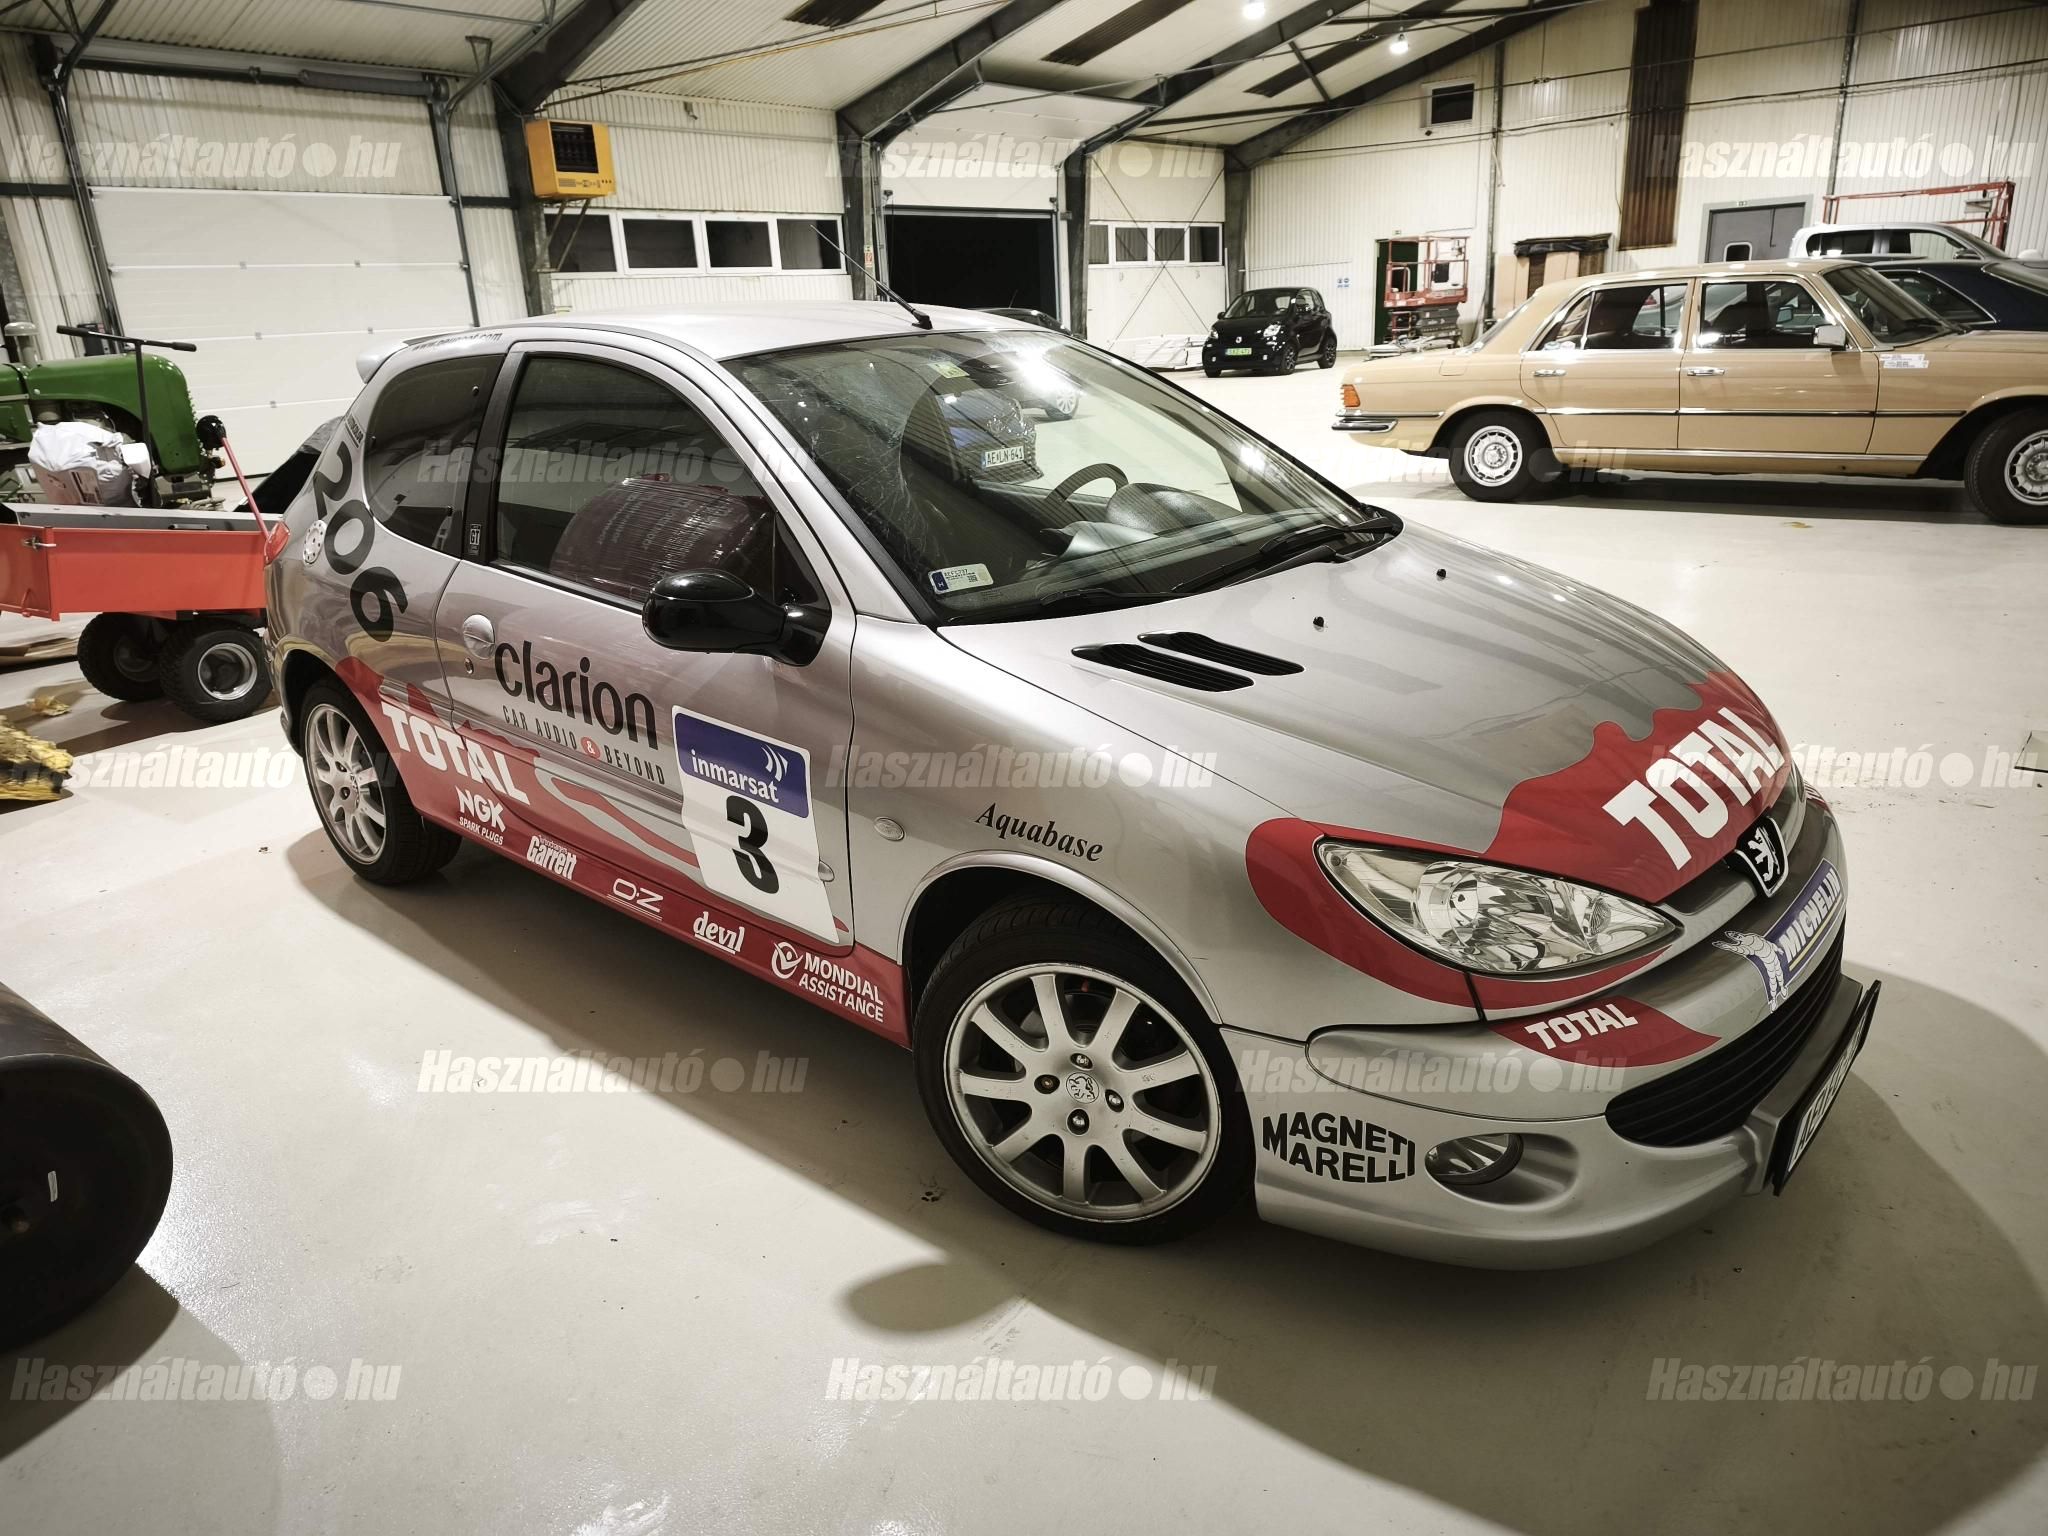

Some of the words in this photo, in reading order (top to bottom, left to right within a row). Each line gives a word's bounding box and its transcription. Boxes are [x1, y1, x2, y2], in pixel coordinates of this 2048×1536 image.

[313, 441, 409, 642] 206
[381, 701, 530, 805] TOTAL
[503, 705, 528, 731] CAR
[535, 717, 577, 750] AUDIO
[604, 744, 665, 785] BEYOND
[691, 749, 779, 803] inmarsat
[1601, 707, 1785, 870] TOTAL
[455, 785, 506, 833] NGK
[459, 816, 481, 834] SPARK
[481, 827, 504, 846] PLUGS
[974, 802, 1103, 862] Aquabase
[527, 835, 577, 880] Garrett
[726, 795, 779, 894] 3
[693, 911, 745, 953] devil
[1779, 868, 1841, 964] MICHELIN
[798, 973, 884, 1023] ASSISTANCE
[804, 952, 884, 1006] MONDIAL
[1524, 1003, 1639, 1050] TOTAL
[1263, 1112, 1415, 1160] MAGNETI
